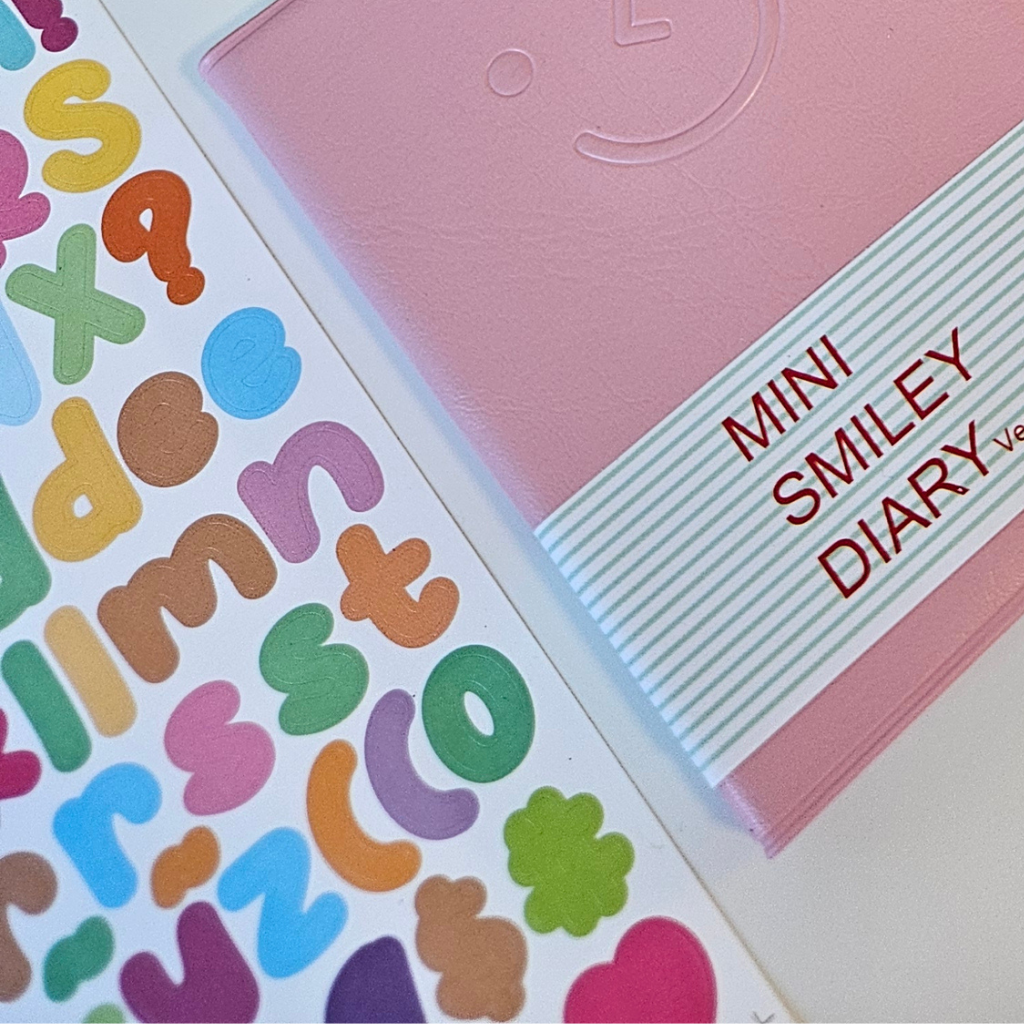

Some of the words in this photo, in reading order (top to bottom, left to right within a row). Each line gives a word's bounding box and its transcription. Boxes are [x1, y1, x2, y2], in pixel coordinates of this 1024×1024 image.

[32, 397, 143, 562] d
[721, 334, 853, 462] MINI
[772, 326, 972, 525] SMILEY
[97, 514, 278, 683] m
[237, 423, 385, 564] n
[336, 524, 460, 649] t
[817, 420, 990, 599] DIARY
